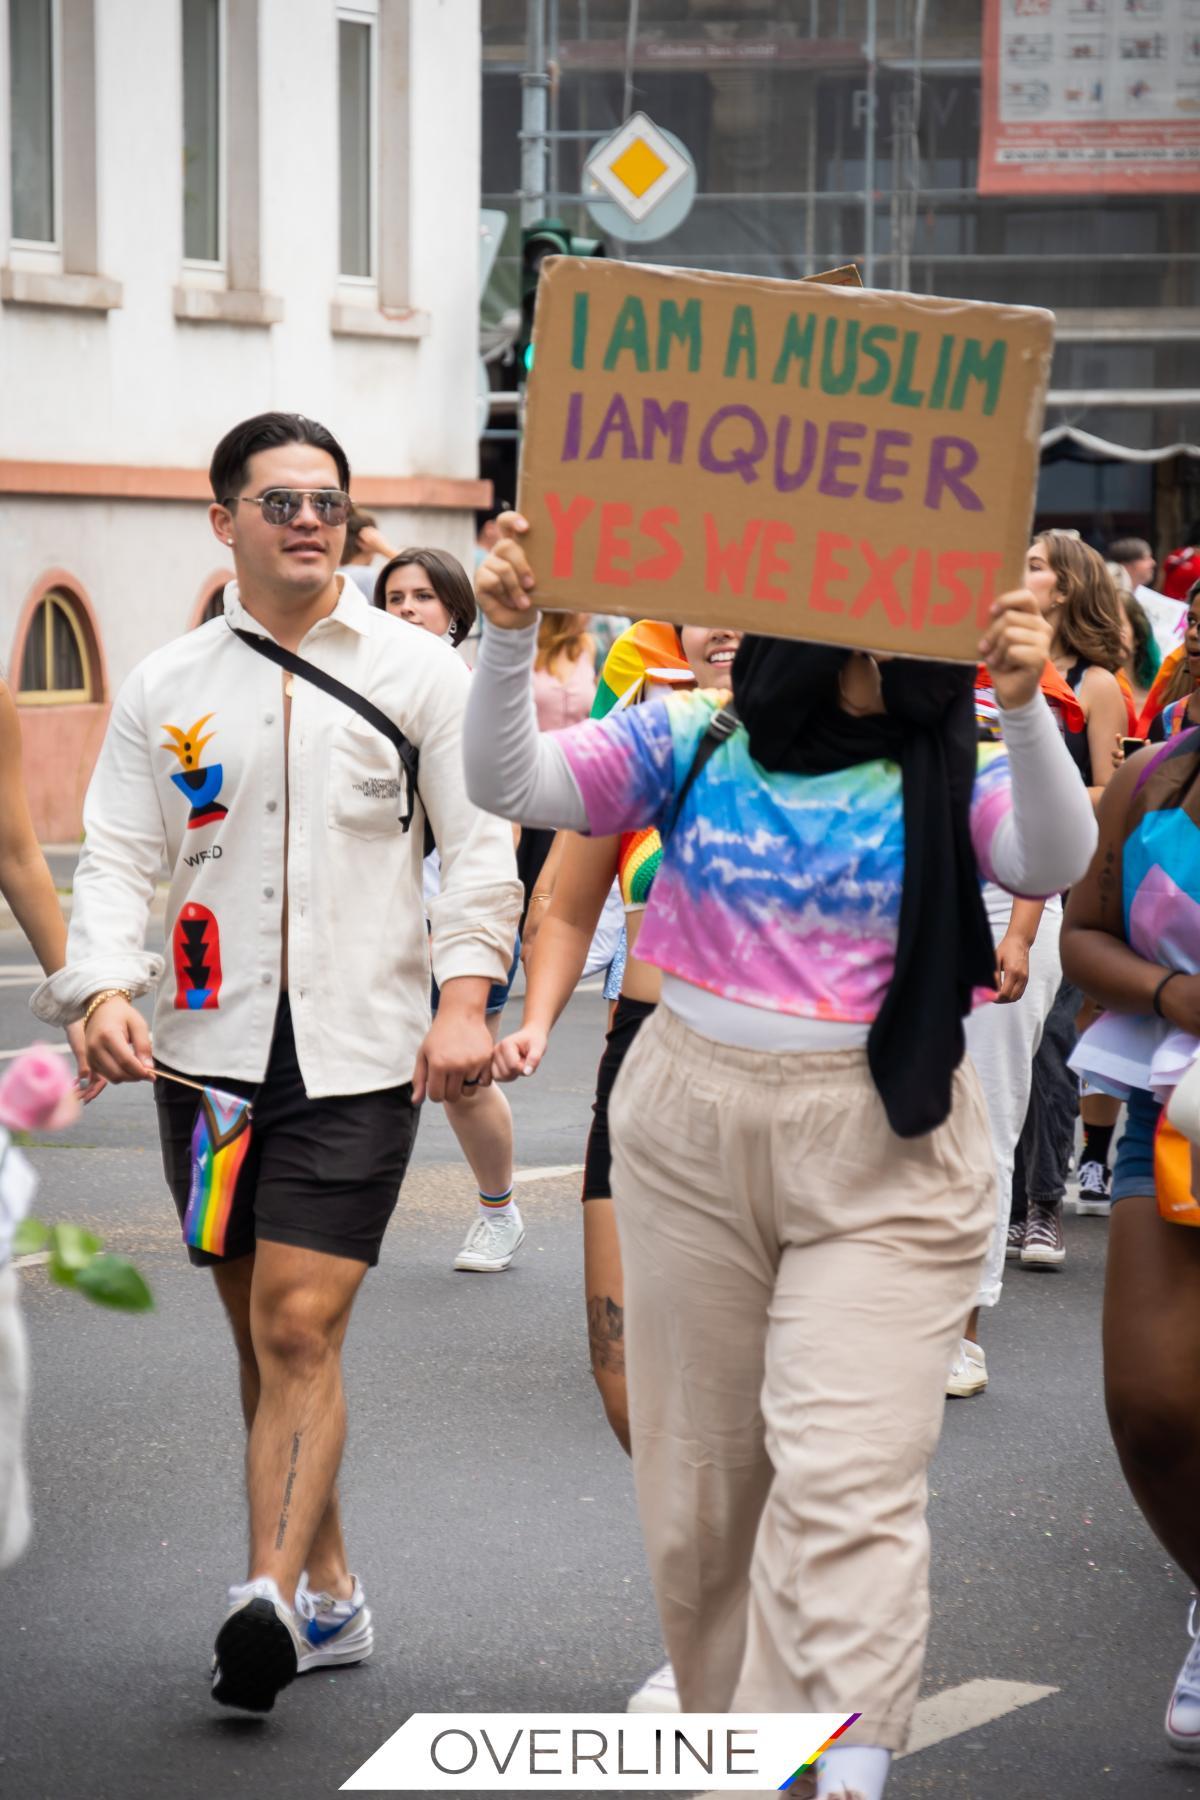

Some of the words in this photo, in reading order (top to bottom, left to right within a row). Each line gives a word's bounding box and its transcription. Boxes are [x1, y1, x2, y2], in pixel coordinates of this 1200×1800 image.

[571, 292, 589, 370] I
[603, 296, 703, 373] AM
[724, 305, 757, 380] A
[773, 312, 1006, 416] MUSLIM
[561, 393, 583, 462] I
[587, 393, 690, 464] AM
[699, 405, 985, 512] QUEER
[544, 492, 684, 588] YES
[703, 512, 797, 603] WE
[808, 530, 1004, 632] EXIST
